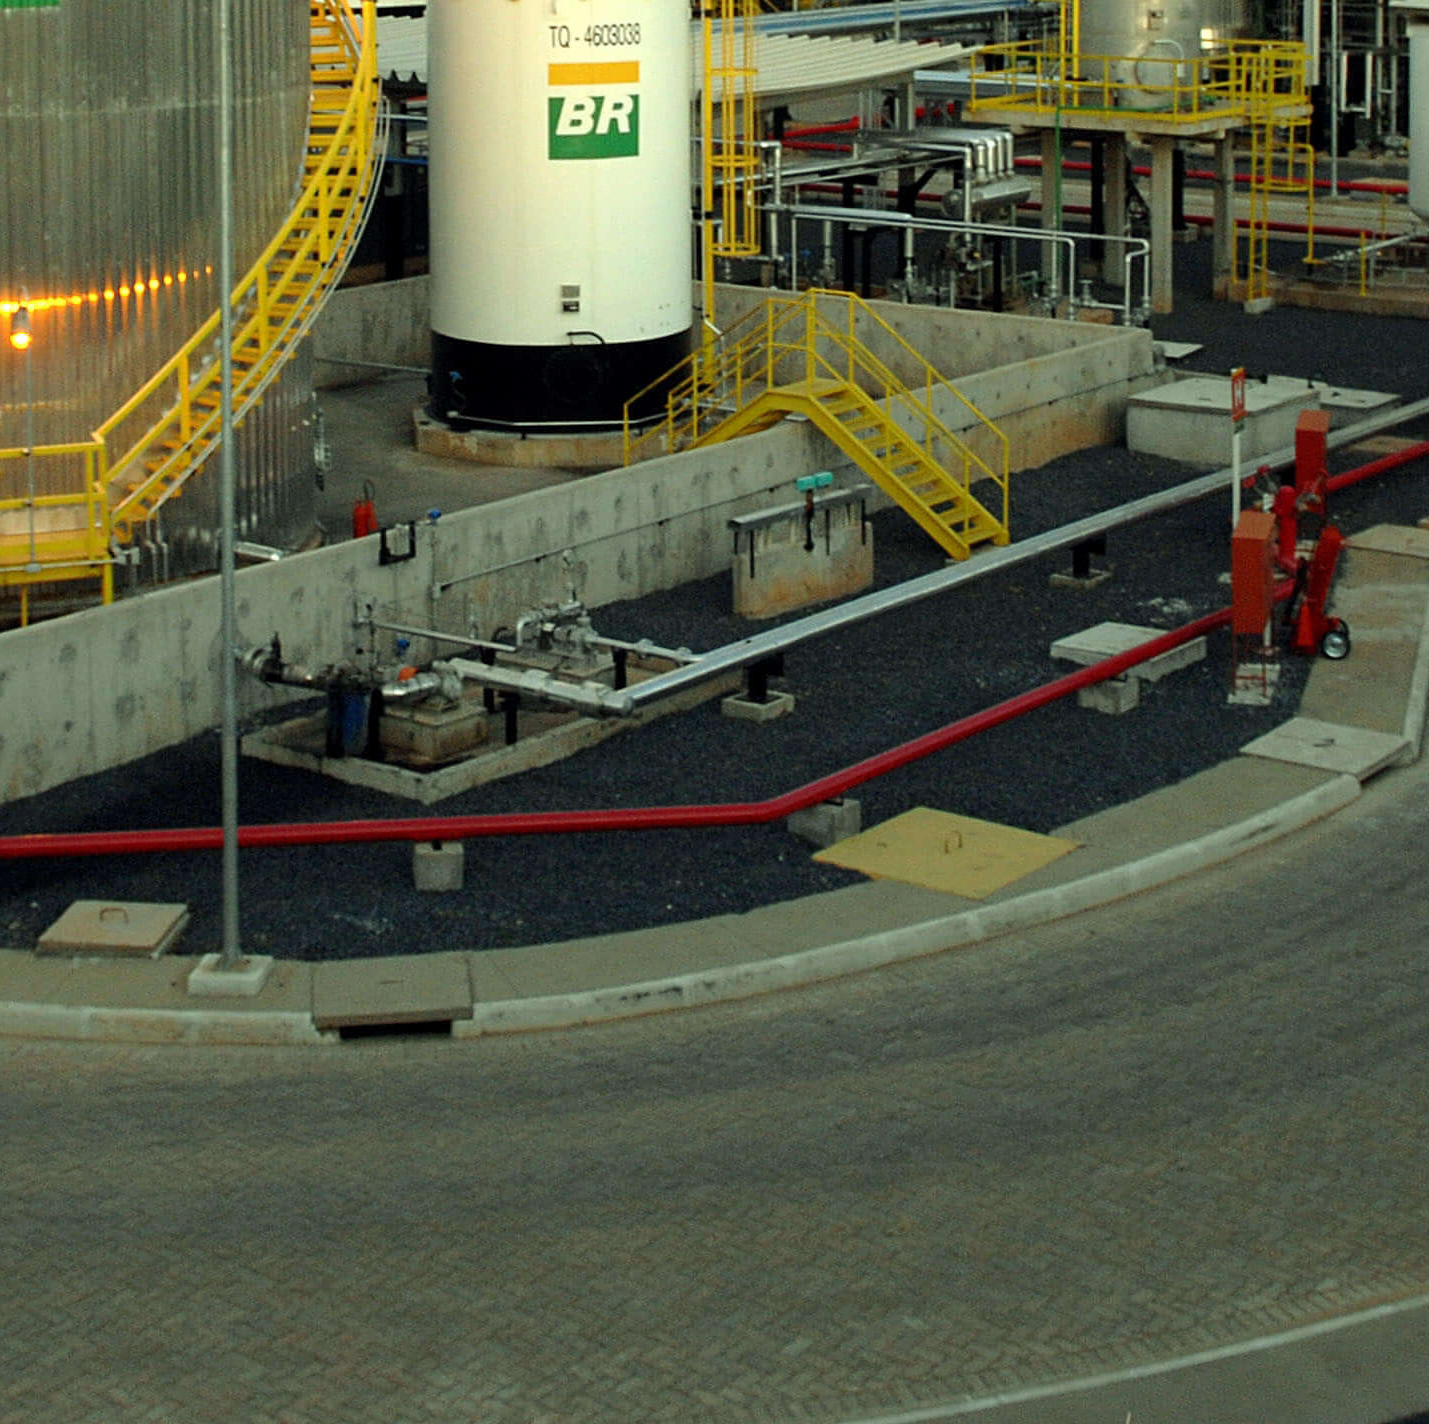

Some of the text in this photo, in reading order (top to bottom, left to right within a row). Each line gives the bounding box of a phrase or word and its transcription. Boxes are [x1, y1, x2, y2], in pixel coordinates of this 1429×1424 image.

[549, 26, 570, 48] TQ
[584, 22, 641, 46] 4603038
[555, 94, 634, 136] BR
